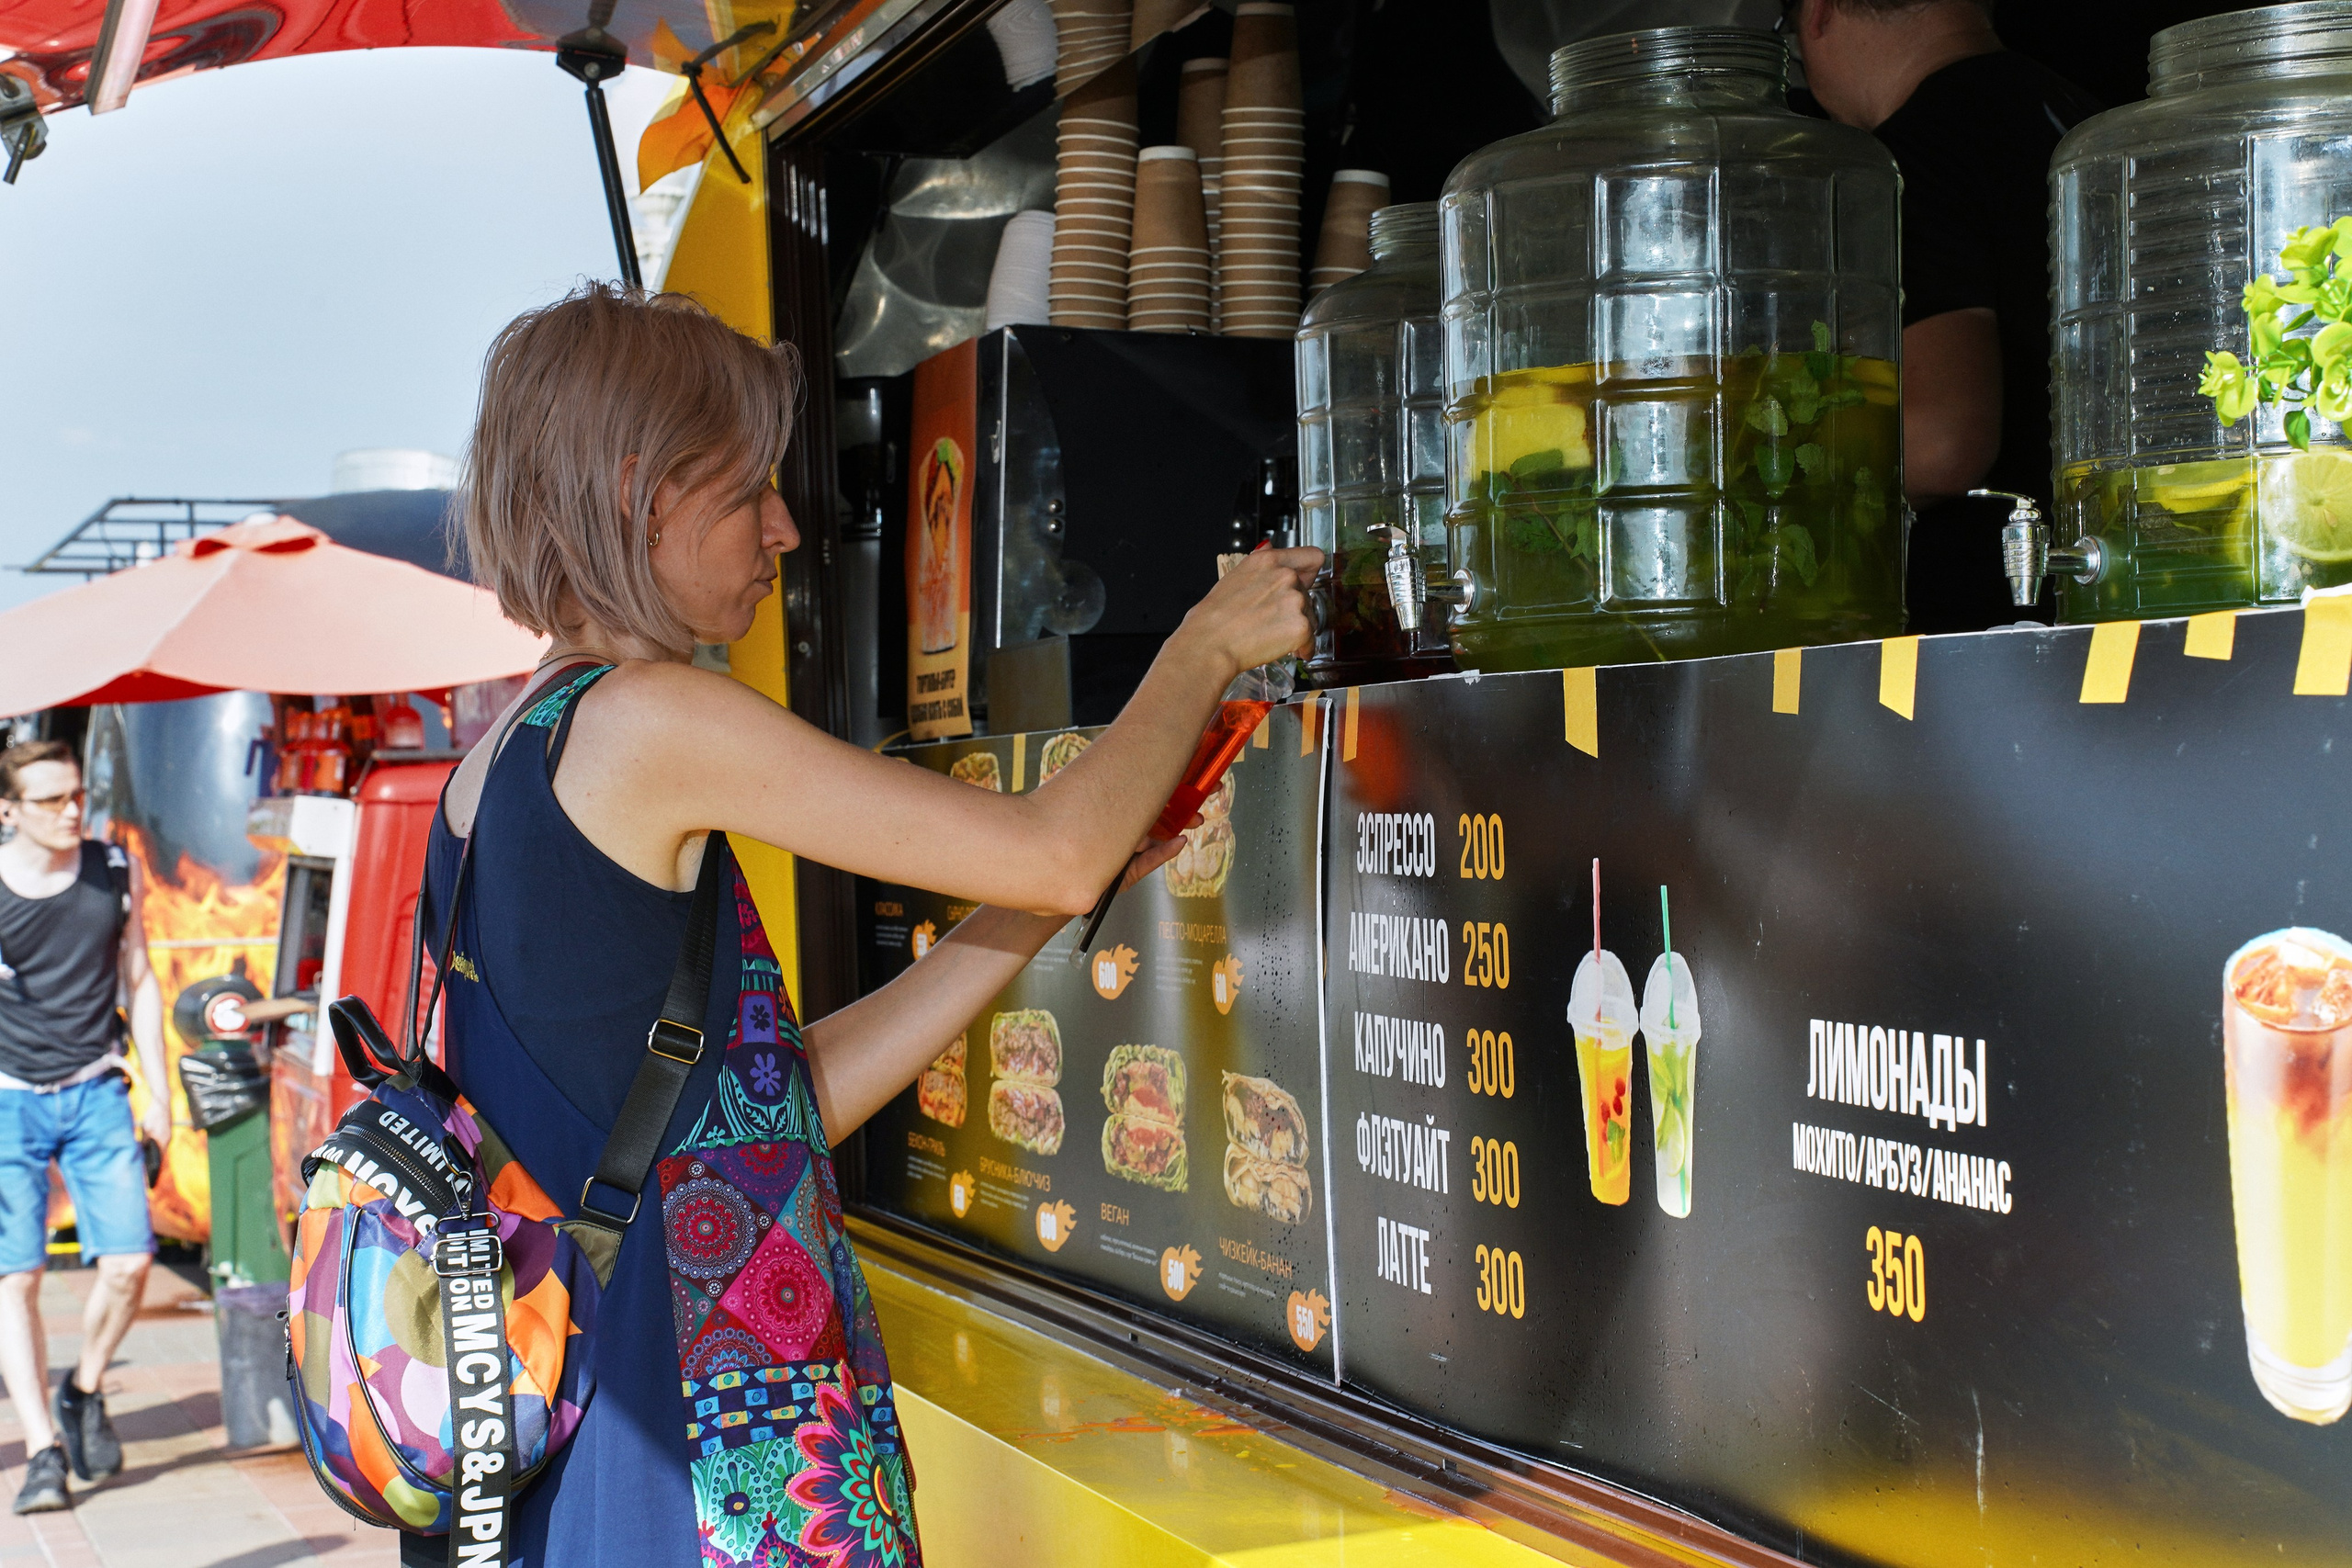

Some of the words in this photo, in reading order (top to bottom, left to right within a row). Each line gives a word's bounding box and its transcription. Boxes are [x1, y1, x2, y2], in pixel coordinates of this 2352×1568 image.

[1357, 812, 1436, 878] ЭСПРЕССО
[1459, 813, 1505, 880] 200
[1158, 921, 1227, 947] ПЕСТО-МОЦАРЕЛЛА
[1349, 911, 1450, 984] АМЕРИКАНО
[1463, 920, 1510, 989] 250
[1098, 961, 1117, 990] 600
[1215, 973, 1227, 1004] 600
[1354, 1011, 1446, 1089] КАПУЧИНО
[1467, 1028, 1515, 1099] 300
[1807, 1019, 1987, 1133] ЛИМОНАДЫ
[1356, 1111, 1450, 1194] ФЛЭТУАЙТ
[1470, 1135, 1521, 1209] 300
[1792, 1122, 2013, 1215] МОХИТО/АРБУЗ/АНАНАС
[1040, 1211, 1057, 1242] 600
[1101, 1202, 1130, 1226] ВЕГАН
[469, 1228, 494, 1309] IMITED
[1168, 1258, 1185, 1292] 500
[1218, 1236, 1293, 1280] ЧИЗКЕЙК-БАНАН
[1378, 1216, 1431, 1295] ЛАТТЕ
[1475, 1244, 1525, 1320] 300
[1866, 1225, 1926, 1323] 350
[1295, 1304, 1315, 1342] 550
